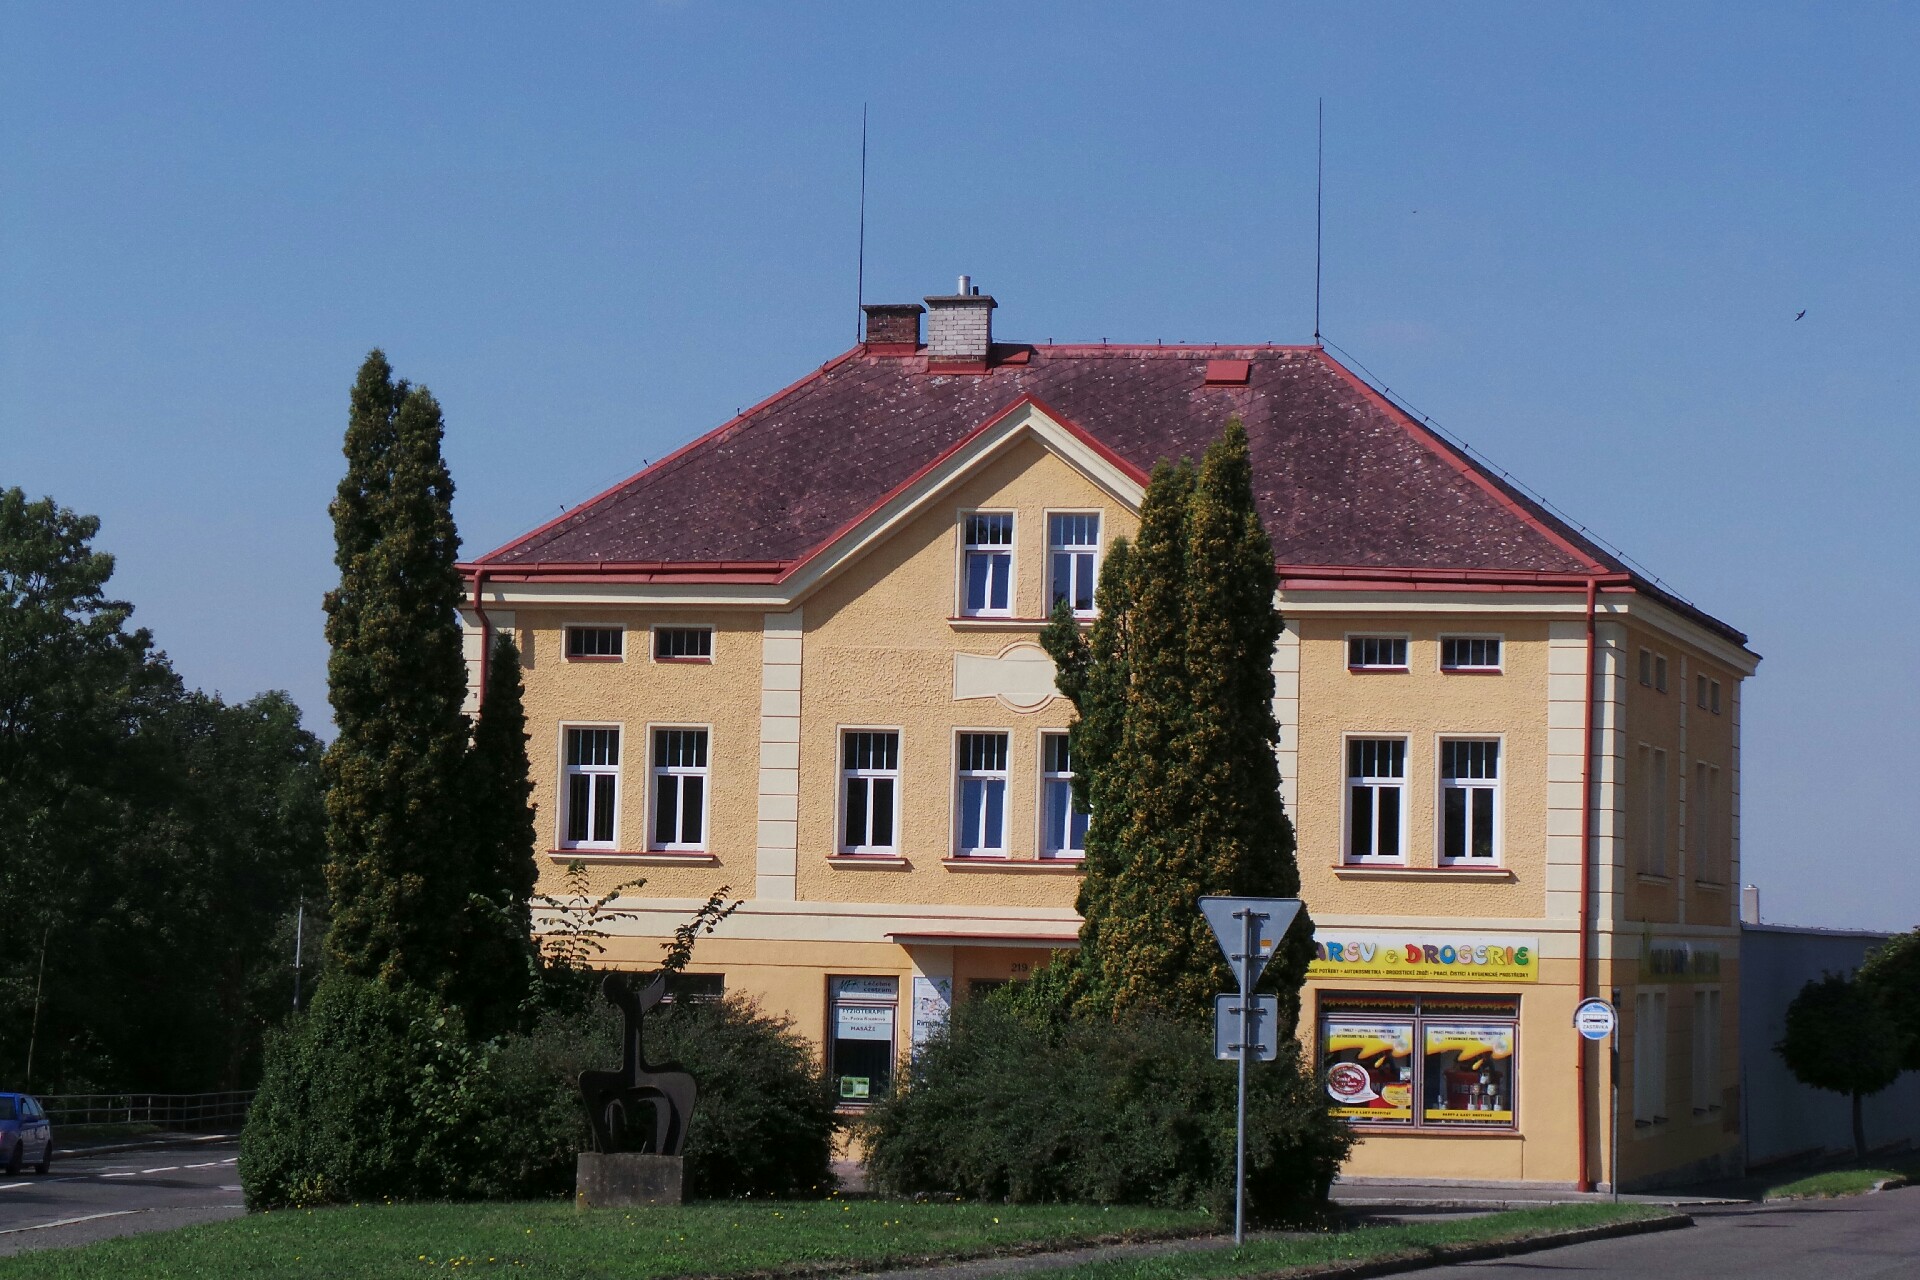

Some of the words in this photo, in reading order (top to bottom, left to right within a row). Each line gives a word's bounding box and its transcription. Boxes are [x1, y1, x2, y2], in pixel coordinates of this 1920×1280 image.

[1315, 941, 1376, 963] AREV
[1404, 943, 1530, 966] DROGERIE
[1011, 963, 1028, 972] 219
